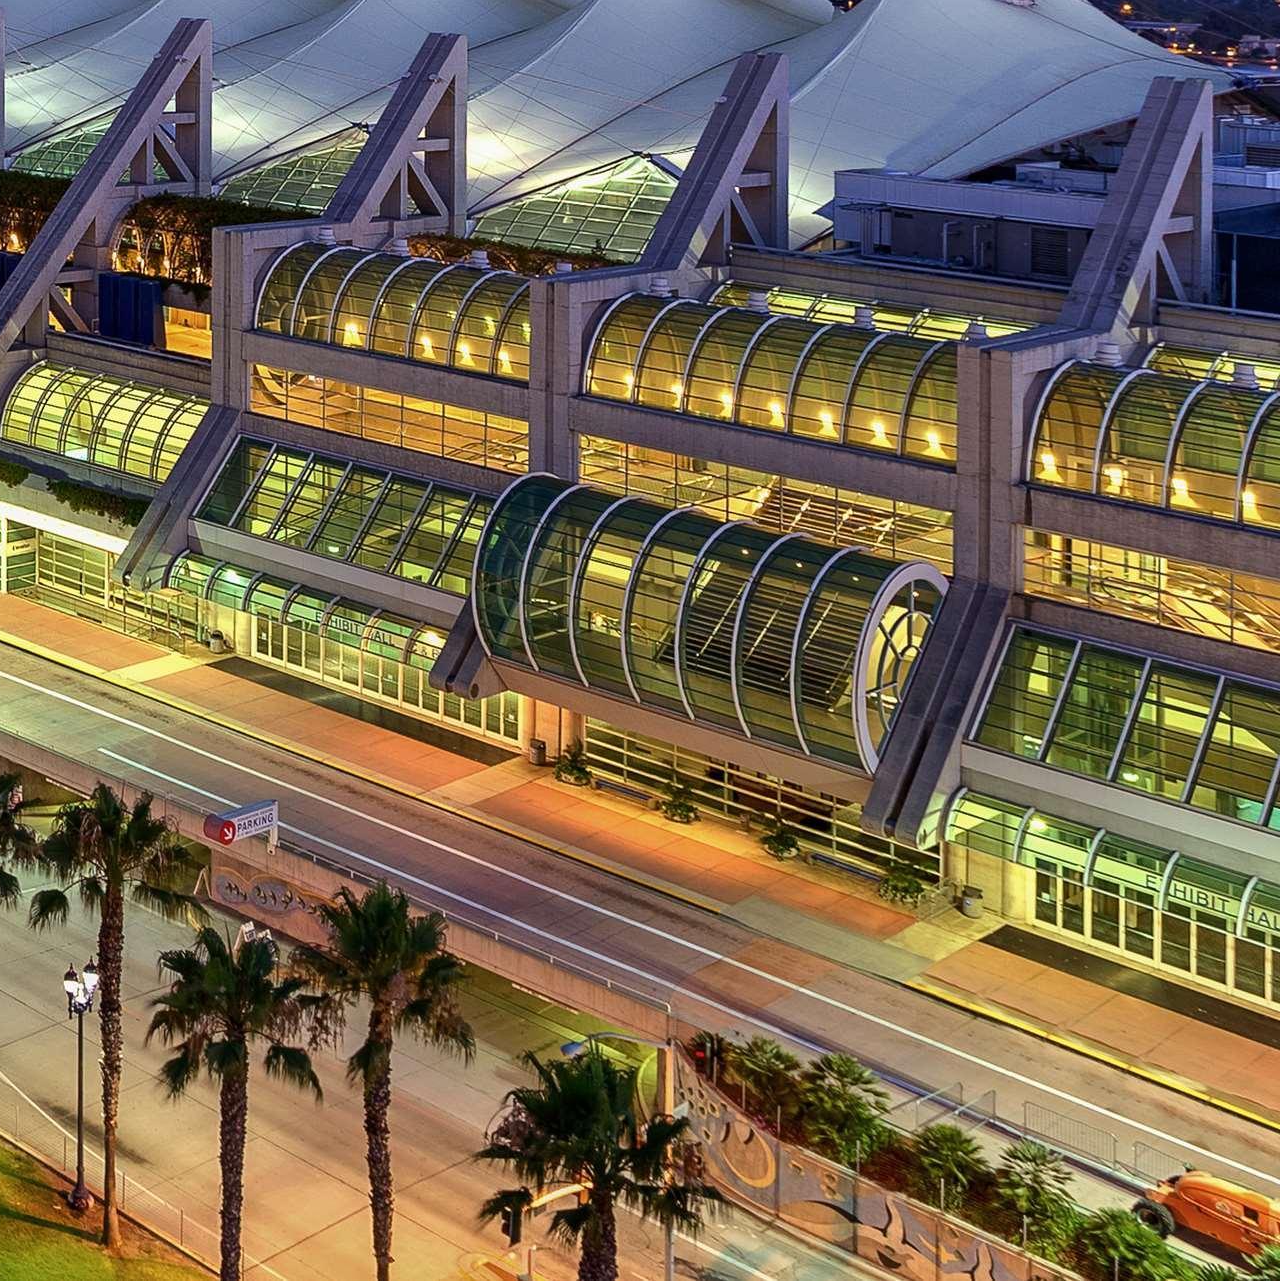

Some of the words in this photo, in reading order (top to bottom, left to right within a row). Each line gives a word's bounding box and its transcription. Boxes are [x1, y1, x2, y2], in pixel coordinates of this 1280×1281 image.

[315, 611, 360, 633] EHIBIT
[237, 813, 274, 833] PARKING
[1145, 874, 1230, 913] EHIBIT
